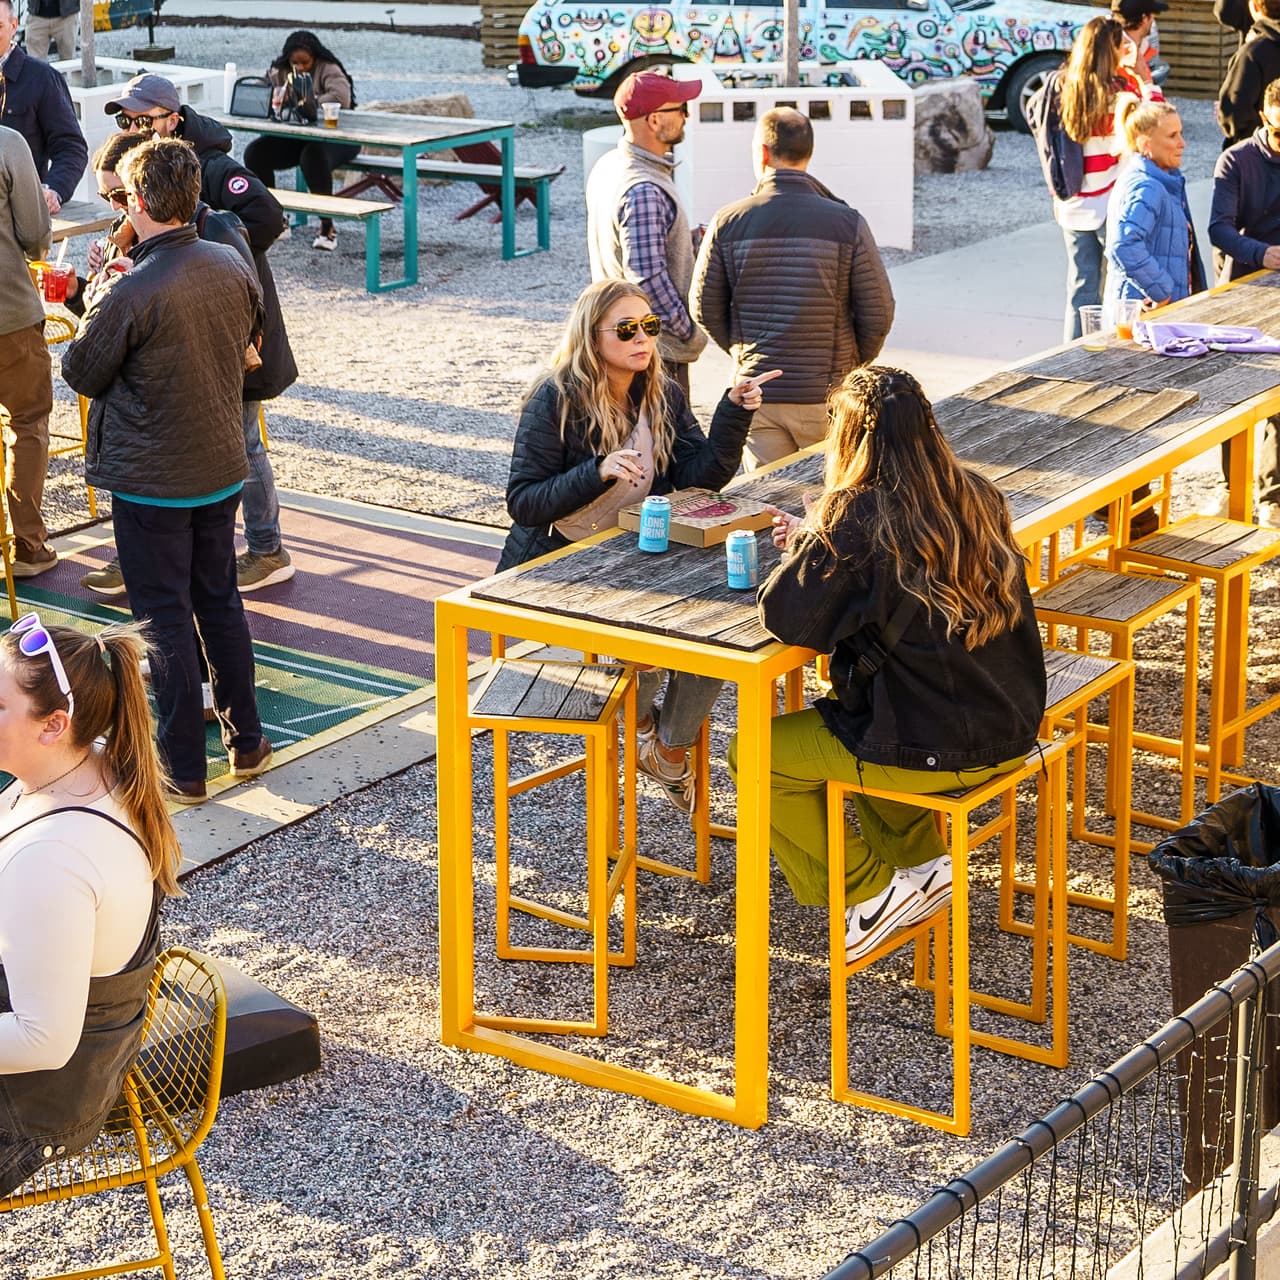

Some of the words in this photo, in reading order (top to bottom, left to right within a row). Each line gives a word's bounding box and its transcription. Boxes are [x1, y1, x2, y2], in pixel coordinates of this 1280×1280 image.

[644, 517, 665, 528] LONG
[642, 526, 666, 539] DRINK
[729, 551, 743, 563] NG
